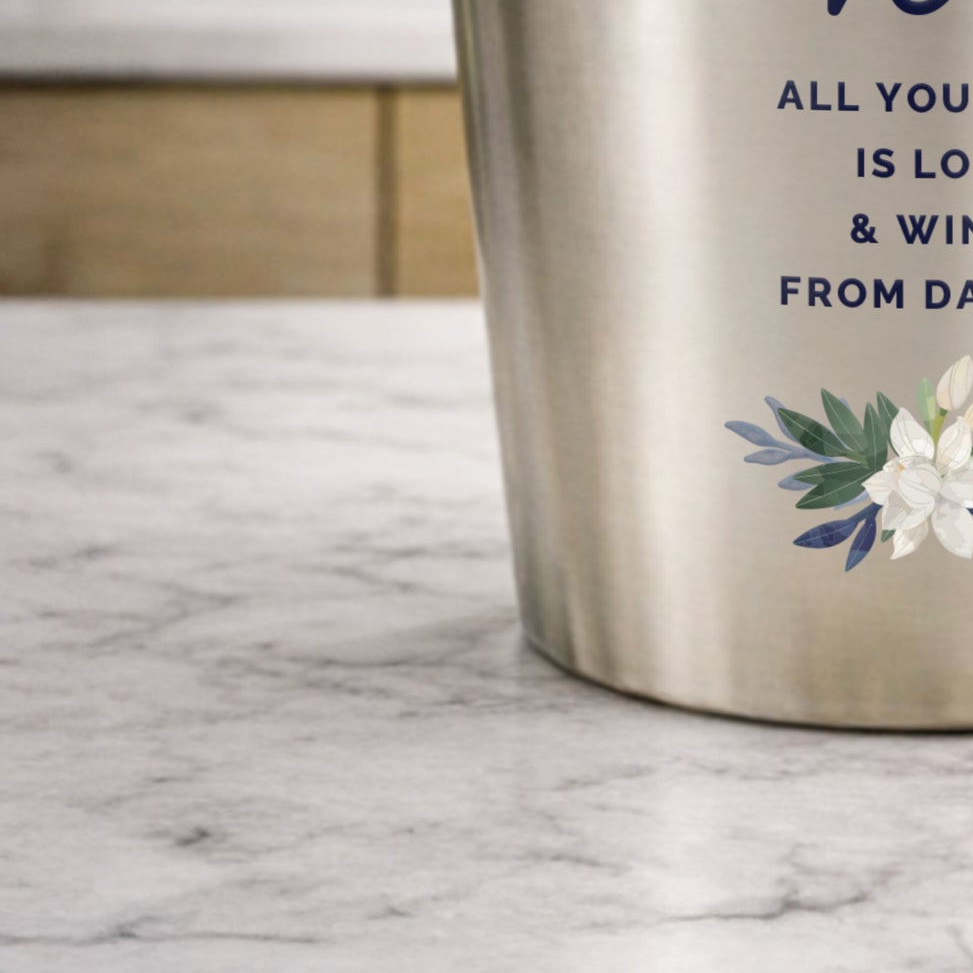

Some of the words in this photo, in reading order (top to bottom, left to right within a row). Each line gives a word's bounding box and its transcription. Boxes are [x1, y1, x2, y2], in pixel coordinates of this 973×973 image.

[777, 80, 860, 112] ALL
[876, 82, 969, 113] YOU
[857, 147, 895, 179] IS
[850, 213, 878, 244] &
[780, 275, 904, 309] FROM
